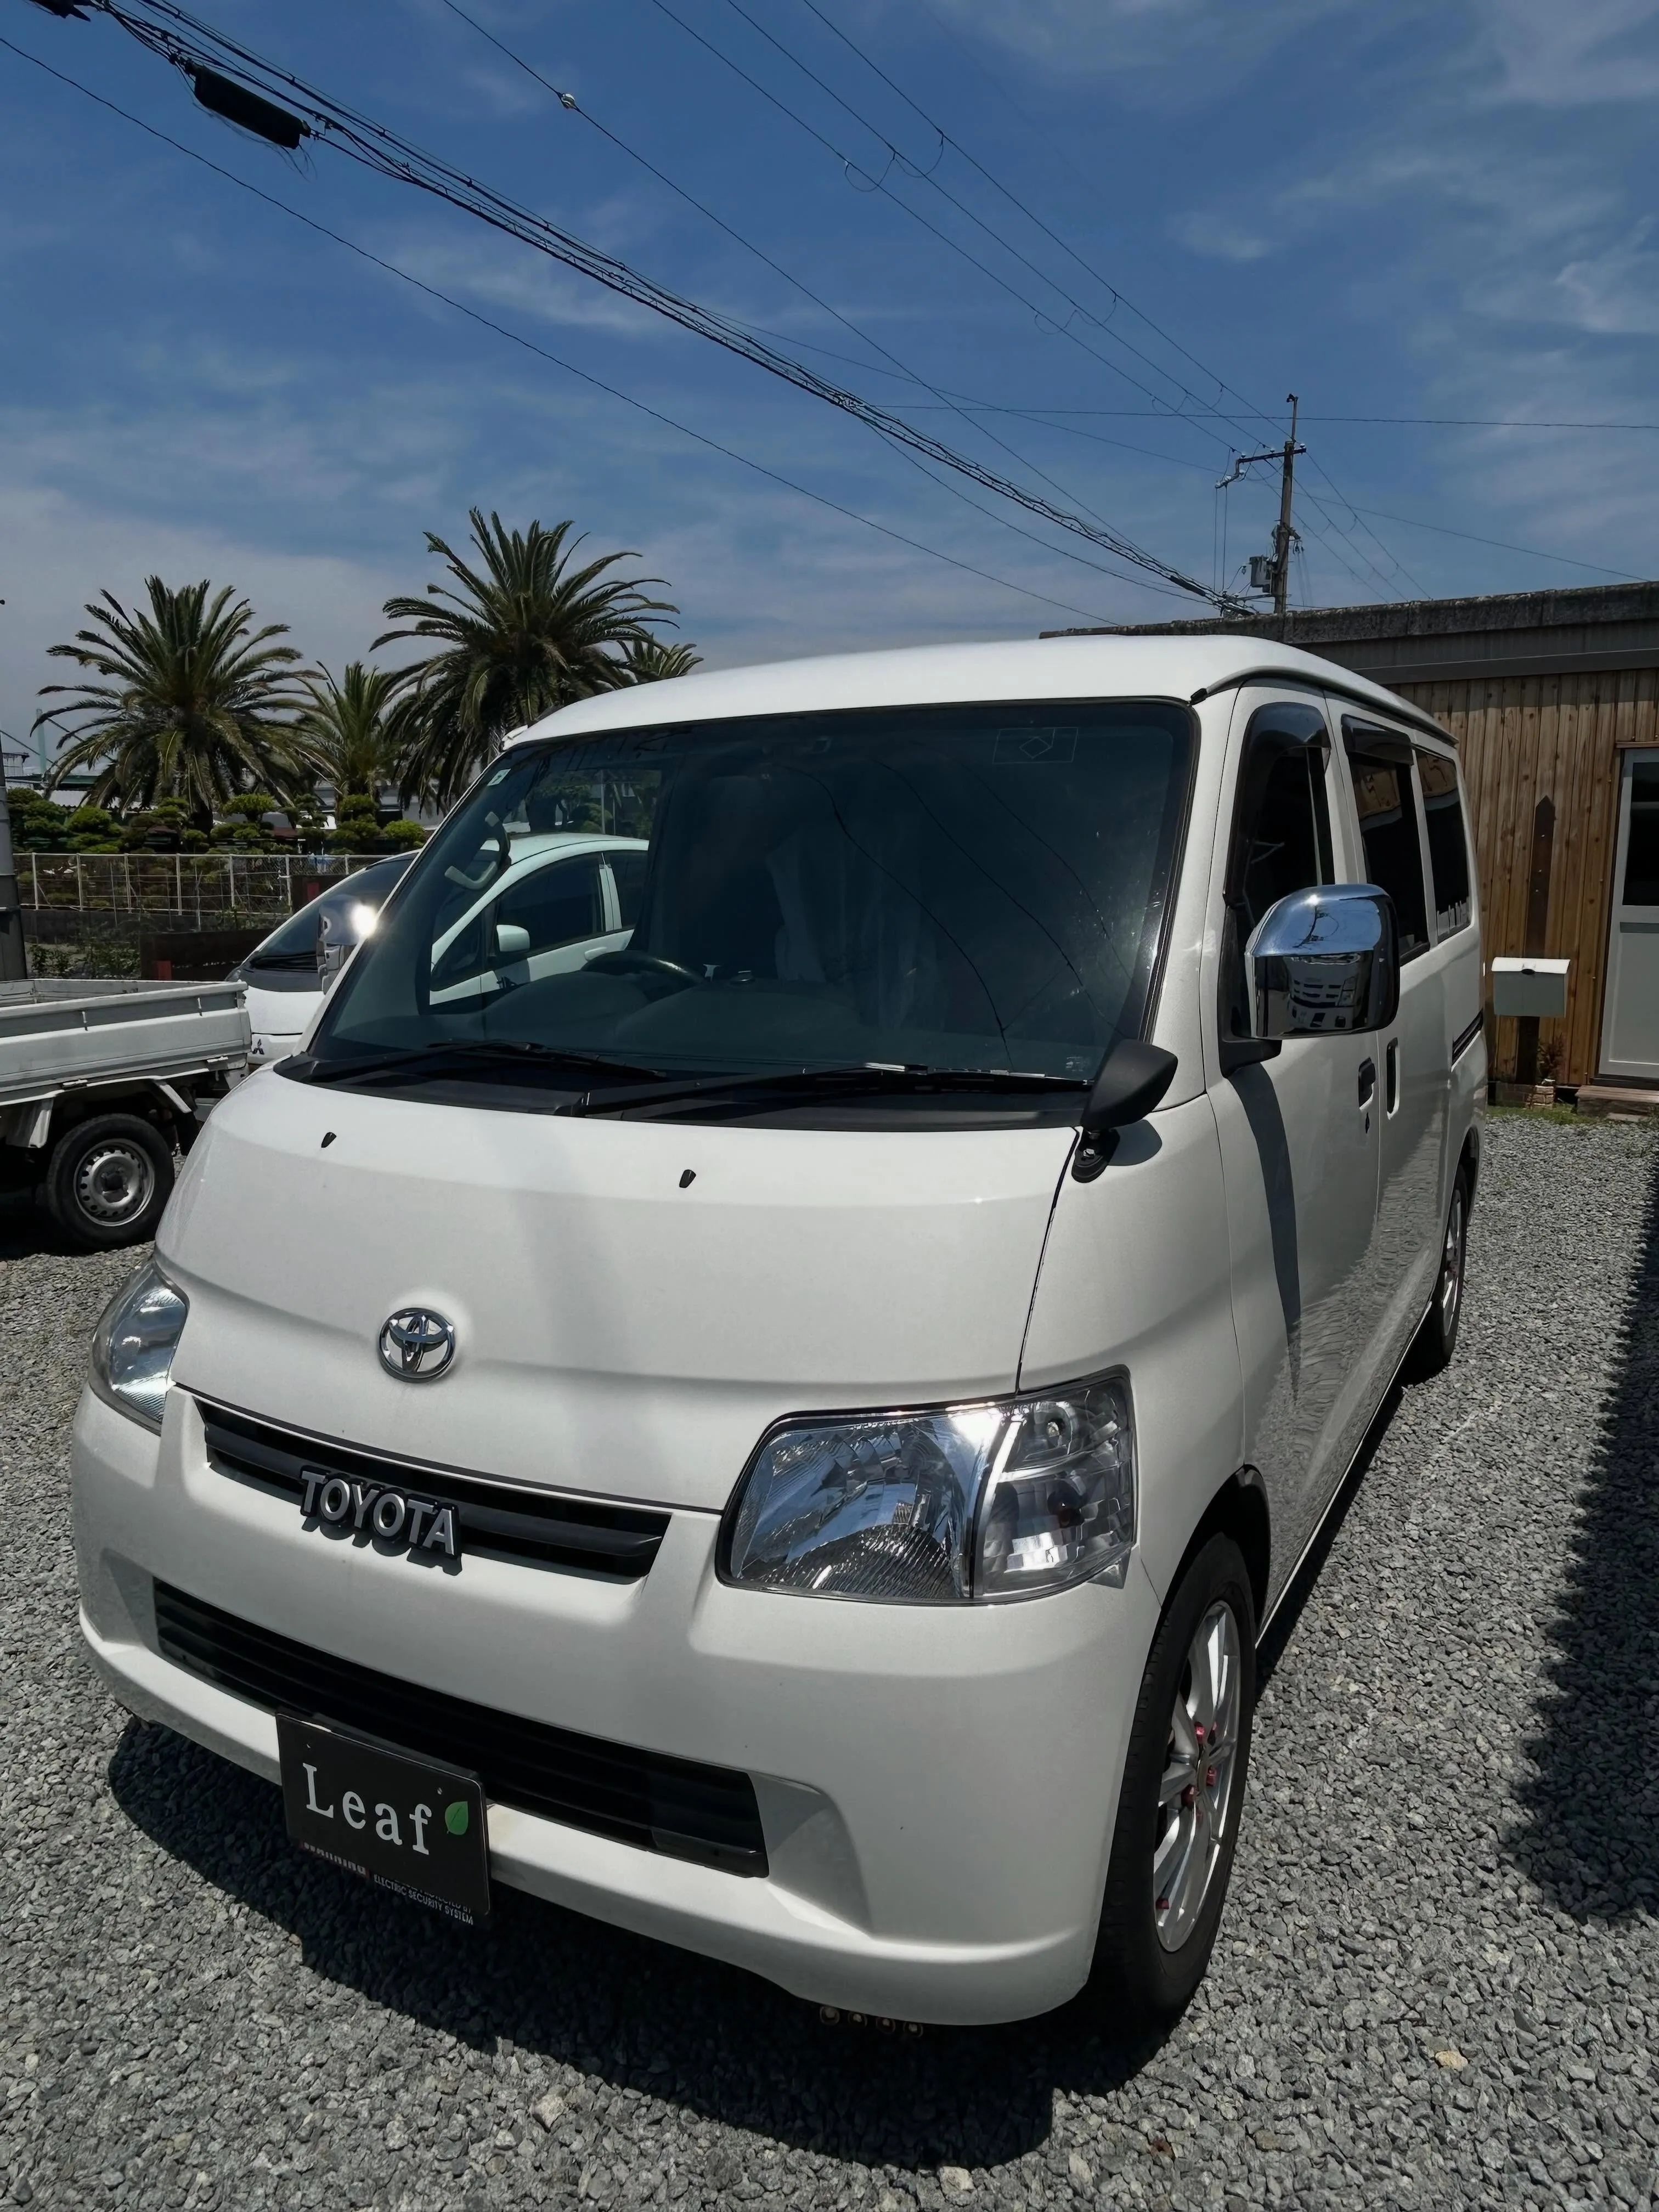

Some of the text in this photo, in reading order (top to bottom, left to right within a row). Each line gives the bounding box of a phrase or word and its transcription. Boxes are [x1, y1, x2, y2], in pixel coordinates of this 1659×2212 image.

[301, 1469, 458, 1556] TOYOTA
[302, 1762, 432, 1855] Leaf
[409, 1888, 443, 1911] SECURITY
[444, 1904, 474, 1926] SYSTEM
